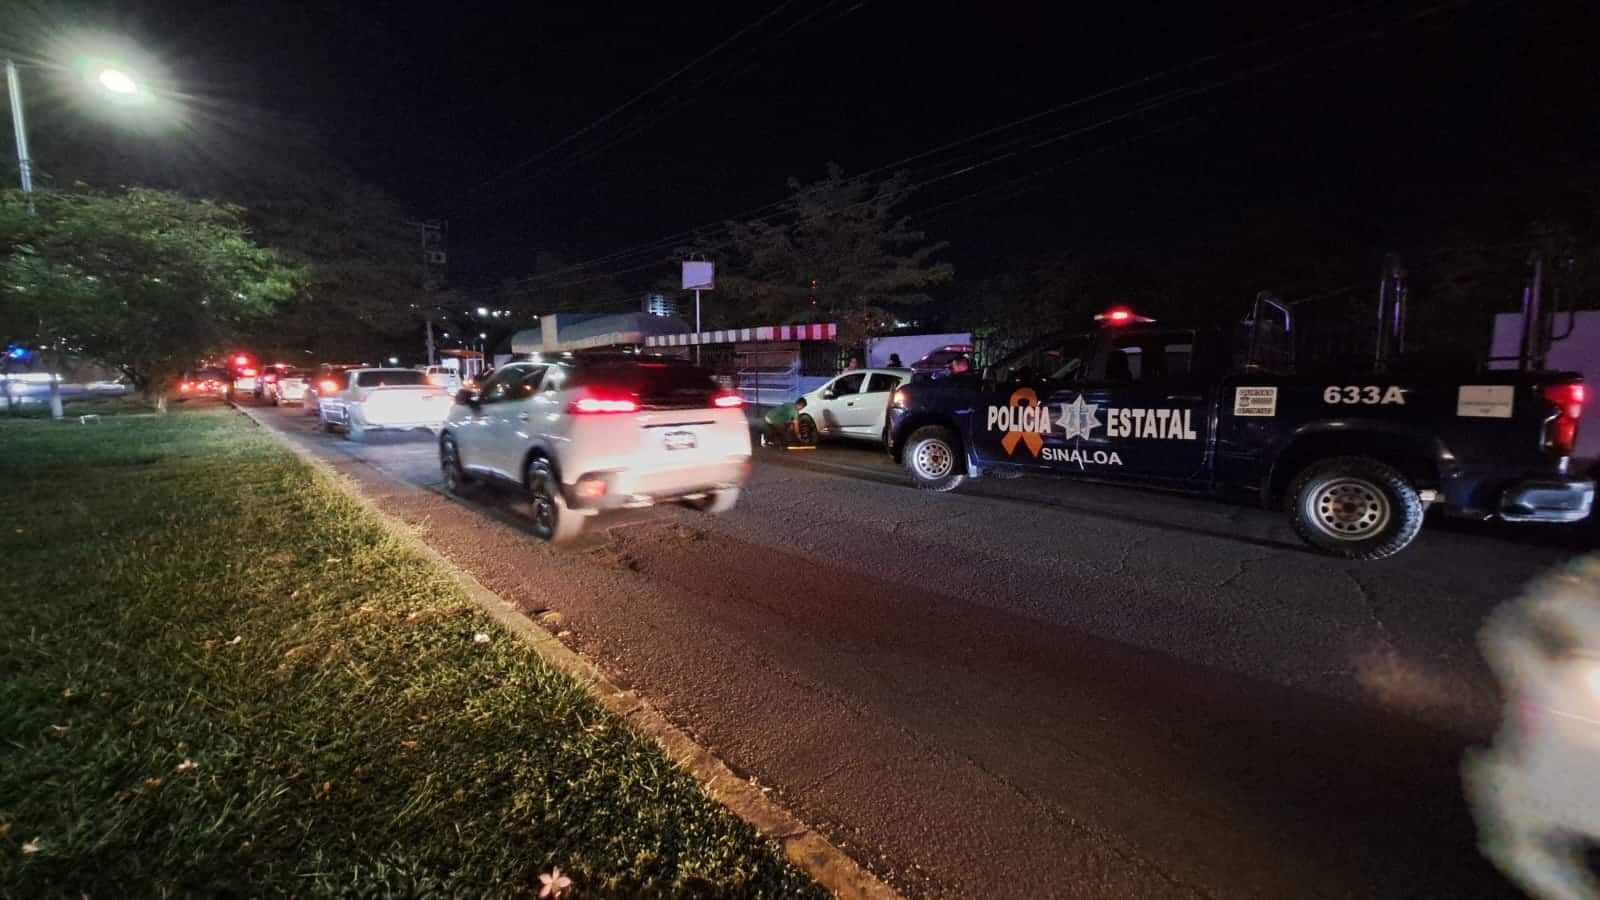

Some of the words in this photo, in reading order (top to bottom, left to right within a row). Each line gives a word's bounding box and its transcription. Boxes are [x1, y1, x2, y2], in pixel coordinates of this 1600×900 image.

[1323, 385, 1405, 404] 633A
[987, 401, 1052, 433] POLICÍA
[1107, 408, 1197, 440] ESTATAL
[1041, 447, 1123, 466] SINALOA
